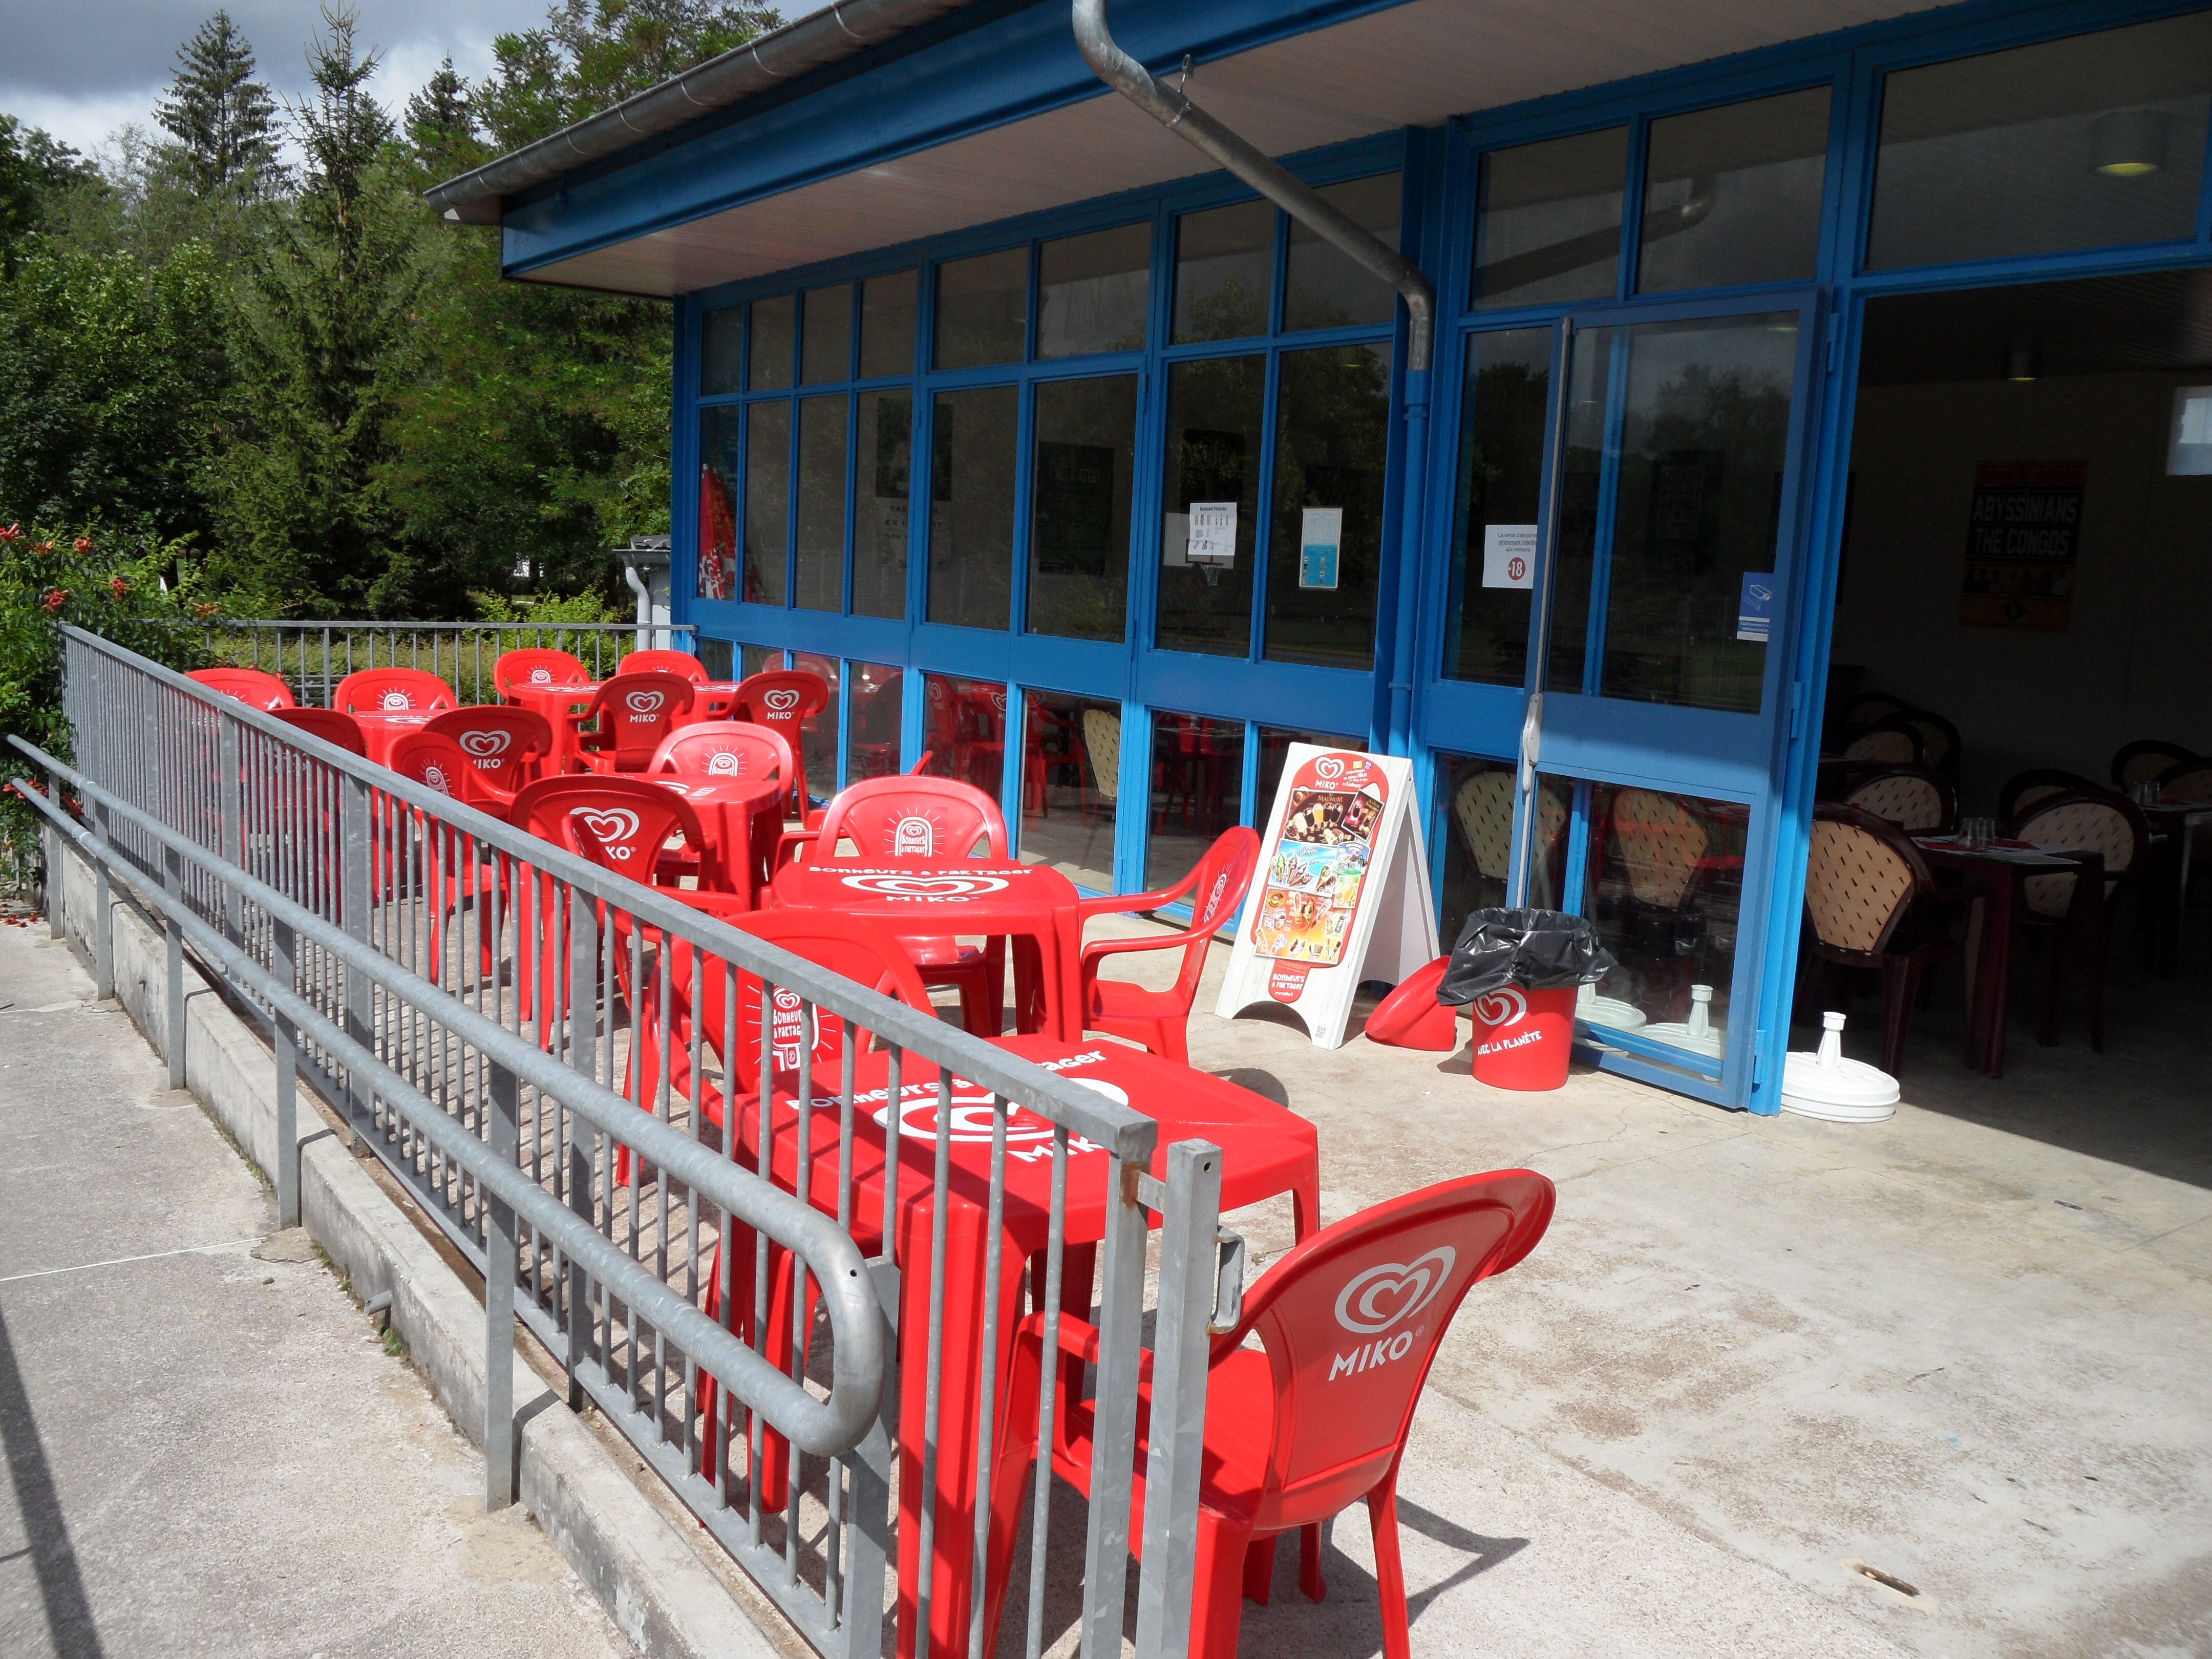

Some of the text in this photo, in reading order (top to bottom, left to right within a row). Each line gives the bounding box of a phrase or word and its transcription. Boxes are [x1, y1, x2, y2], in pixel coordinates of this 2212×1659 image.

[1972, 495, 2079, 523] ABYSSINIANS
[1974, 527, 2070, 557] THE CONGOS
[630, 714, 656, 722] MIKO
[767, 711, 792, 719] MIKO
[1315, 779, 1336, 790] MIKO
[605, 845, 631, 860] KO
[1491, 1041, 1503, 1052] LA
[1502, 1030, 1542, 1050] PLANÈTE
[1328, 1330, 1413, 1381] MIKO
